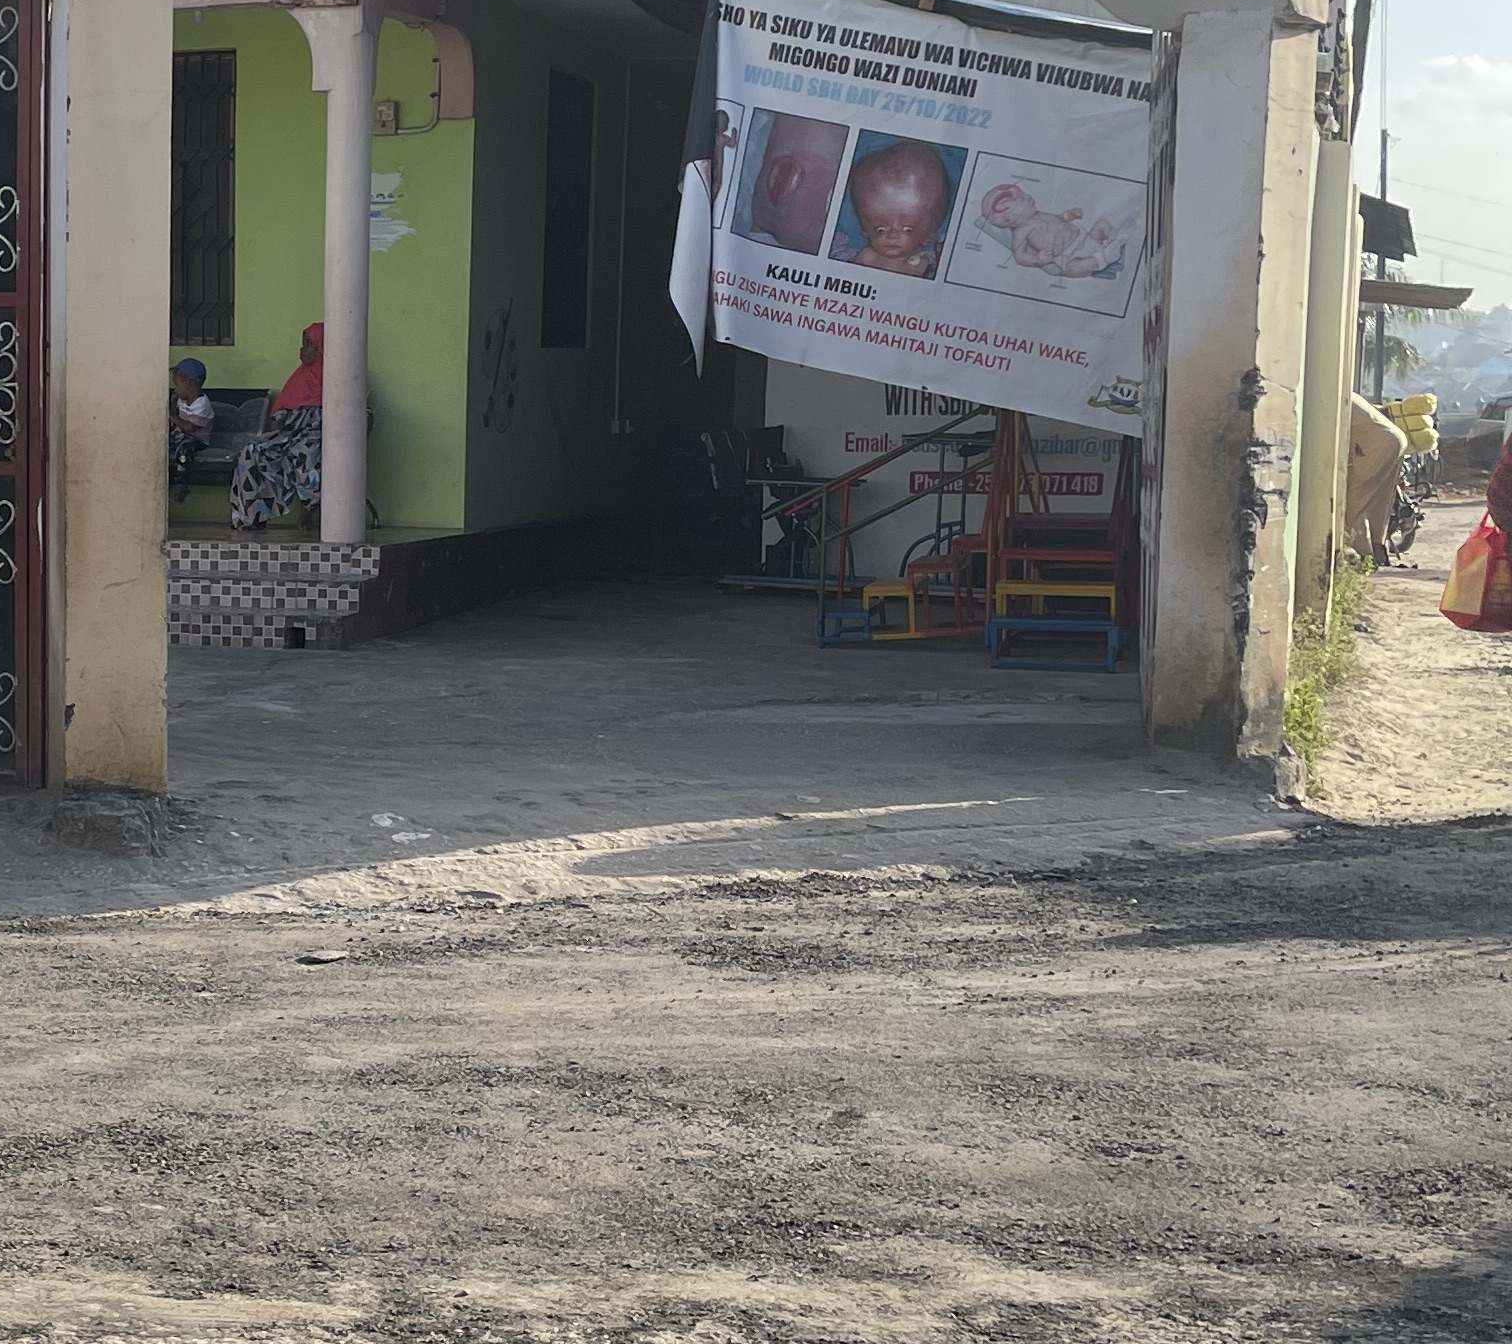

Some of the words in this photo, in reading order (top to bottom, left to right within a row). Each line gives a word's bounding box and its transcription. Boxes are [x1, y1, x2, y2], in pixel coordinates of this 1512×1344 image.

[749, 9, 767, 32] YA
[770, 14, 814, 40] SIKU
[817, 22, 836, 45] YA
[839, 27, 922, 60] ULEMAVU
[924, 41, 955, 67] WA
[958, 48, 1033, 80] VICHWA
[1036, 63, 1124, 98] VIKUBWA
[768, 42, 851, 76] MIGONGO
[853, 58, 901, 84] WAZI
[901, 66, 978, 99] DUNIANI
[743, 64, 807, 93] WORLD
[845, 86, 880, 108] DAY
[881, 92, 993, 130] 25/10/2022
[766, 263, 821, 289] KAULI
[824, 276, 877, 301] MBIU:
[738, 276, 810, 308] ZISIFANYE
[813, 296, 865, 319] MZAZI
[870, 307, 930, 333] WANGU
[933, 322, 989, 346] KUTOA
[993, 333, 1034, 354] UHAI
[1039, 342, 1090, 368] WAKE,
[753, 304, 793, 328] SAWA
[797, 314, 861, 341] INGAWA
[865, 329, 939, 356] MAHITAJI
[944, 345, 1012, 372] TOFAUTI
